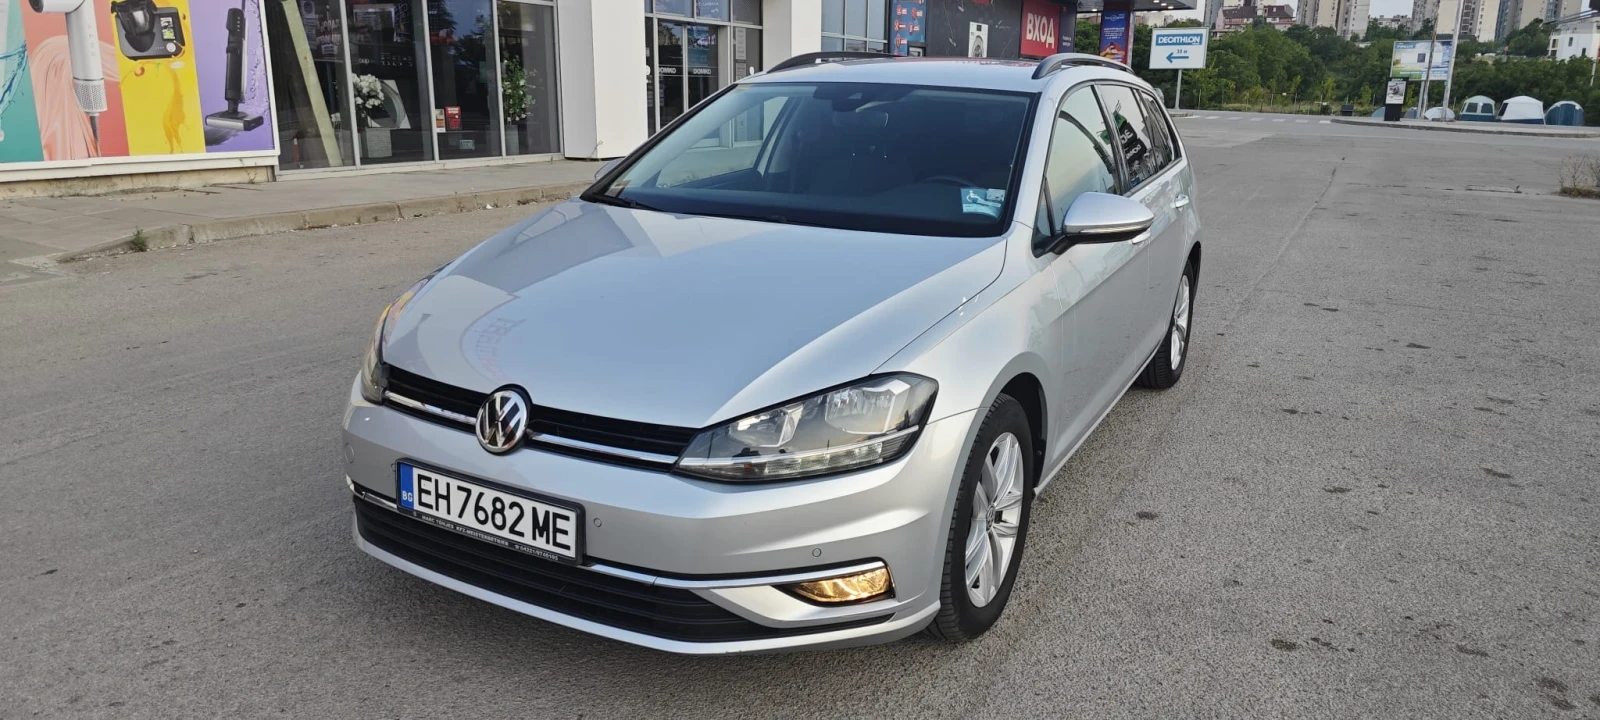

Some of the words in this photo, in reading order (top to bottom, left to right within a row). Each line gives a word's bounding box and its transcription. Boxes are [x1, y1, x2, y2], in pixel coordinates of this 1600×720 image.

[1026, 13, 1055, 49] ВХОД
[1158, 36, 1201, 44] DECATHLON
[402, 490, 413, 502] BG
[418, 474, 451, 515] EH
[457, 485, 525, 537] 7682
[532, 506, 571, 551] ME
